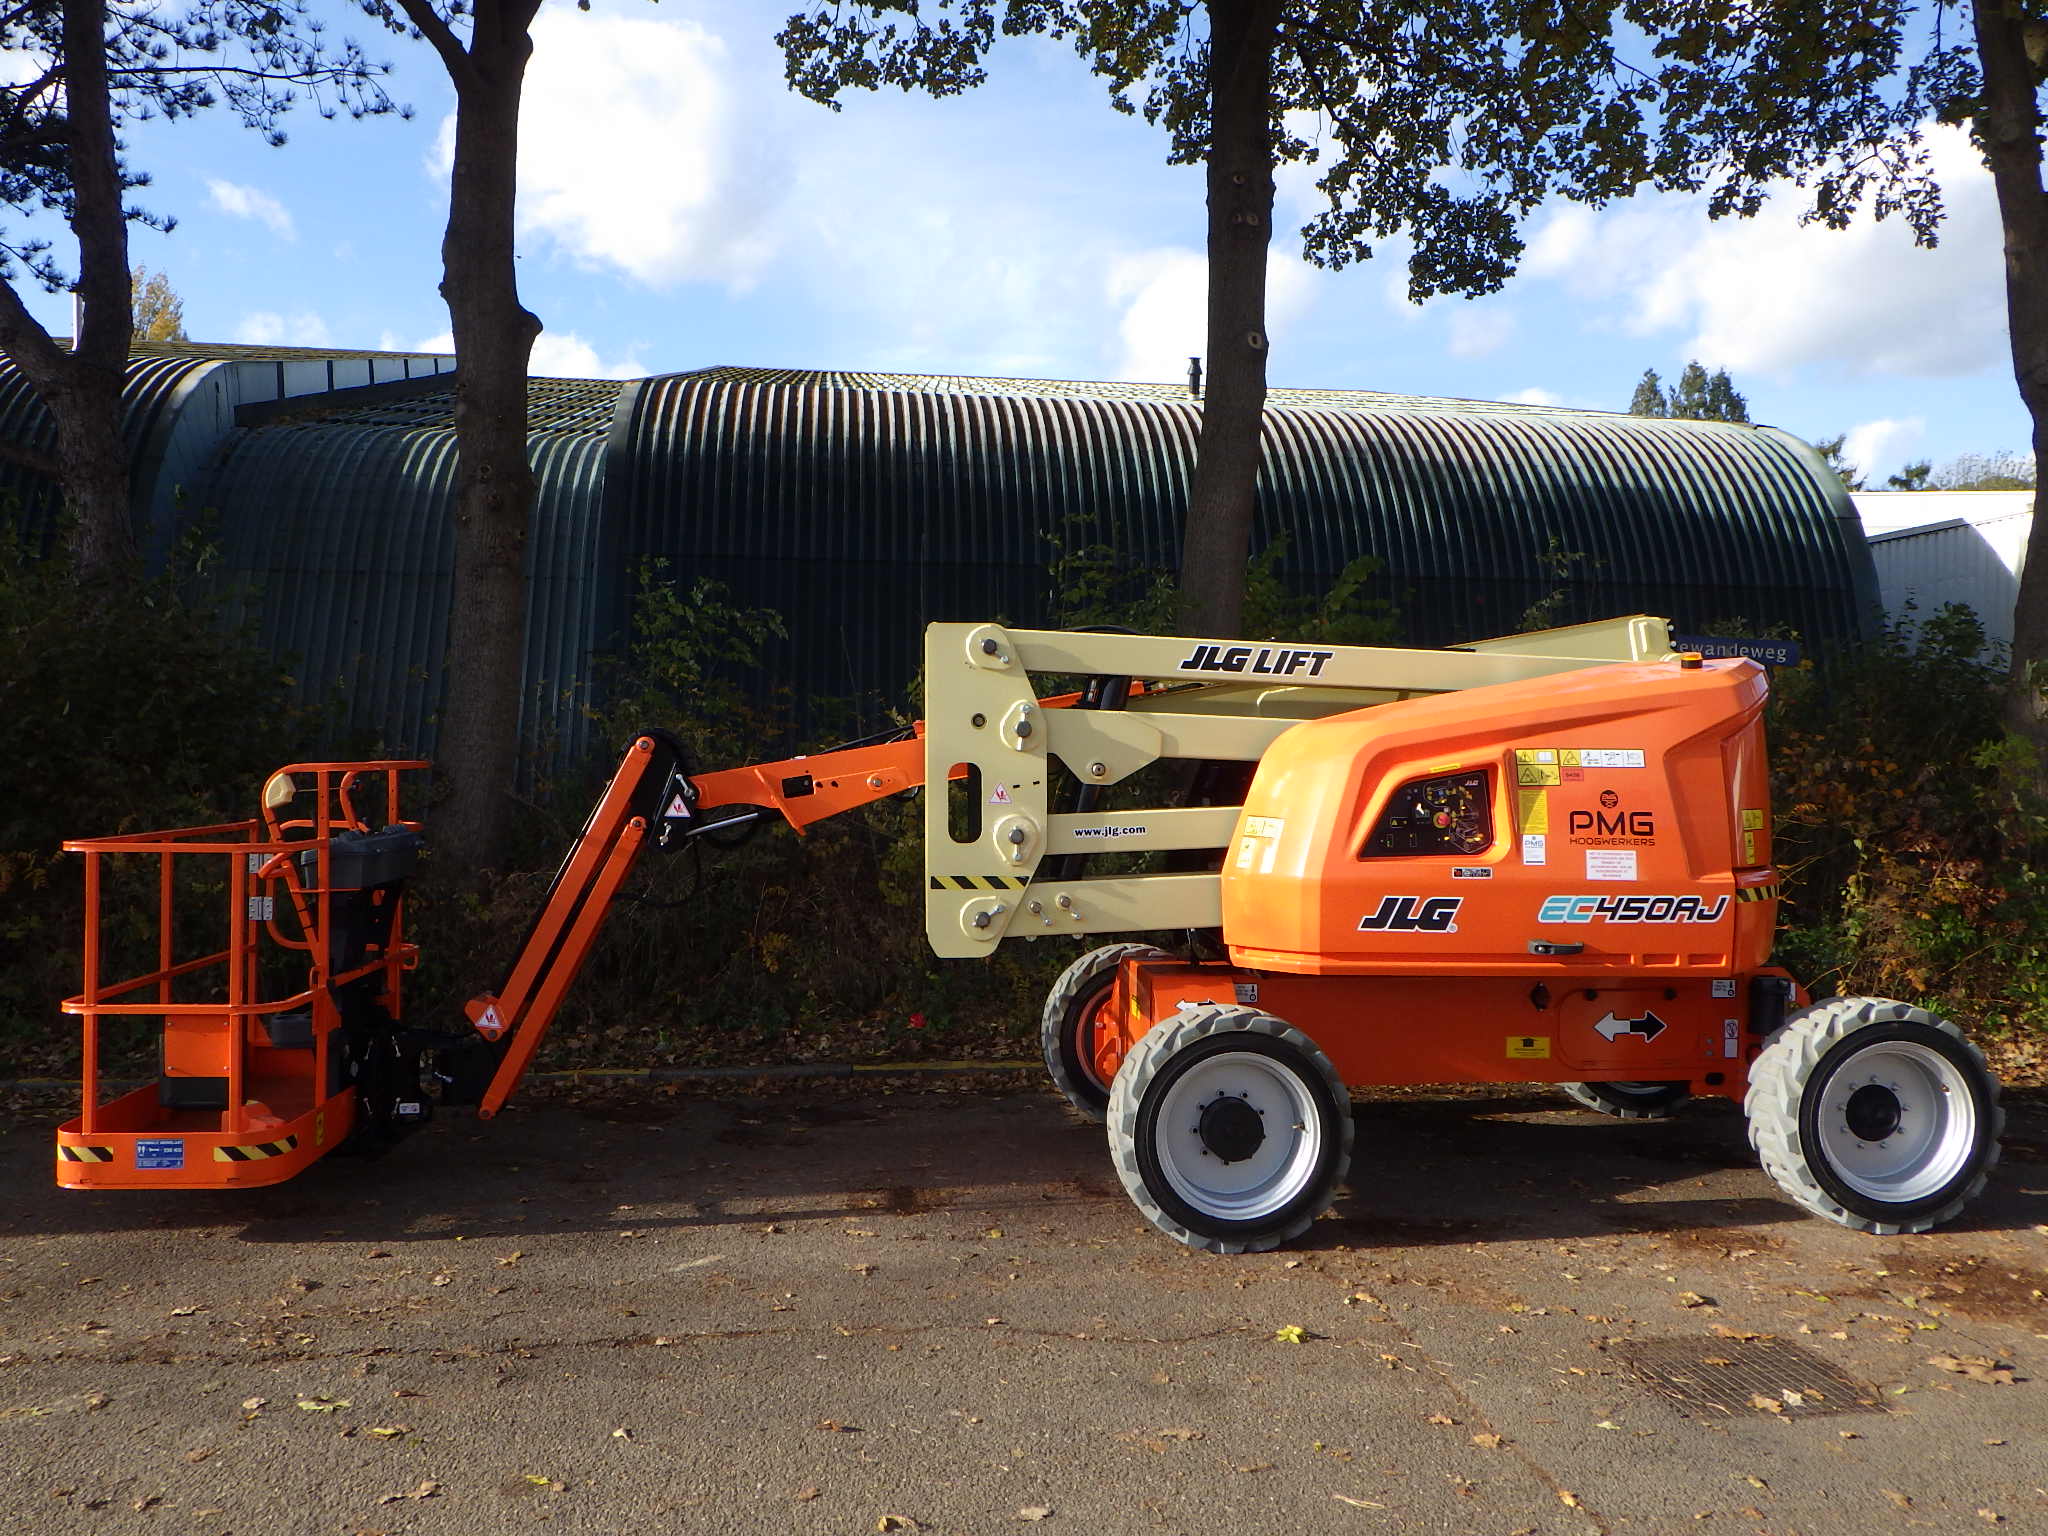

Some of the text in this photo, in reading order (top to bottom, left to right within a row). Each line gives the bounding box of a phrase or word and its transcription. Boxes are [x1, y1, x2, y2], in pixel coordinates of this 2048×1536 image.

[1180, 645, 1334, 677] JLG LIFT
[1680, 642, 1786, 662] ewandeweg
[1074, 826, 1146, 837] www.jlg.com
[1569, 810, 1654, 836] PMG
[1569, 837, 1656, 846] HOOGWERKERS
[1538, 896, 1730, 923] EC450AJ
